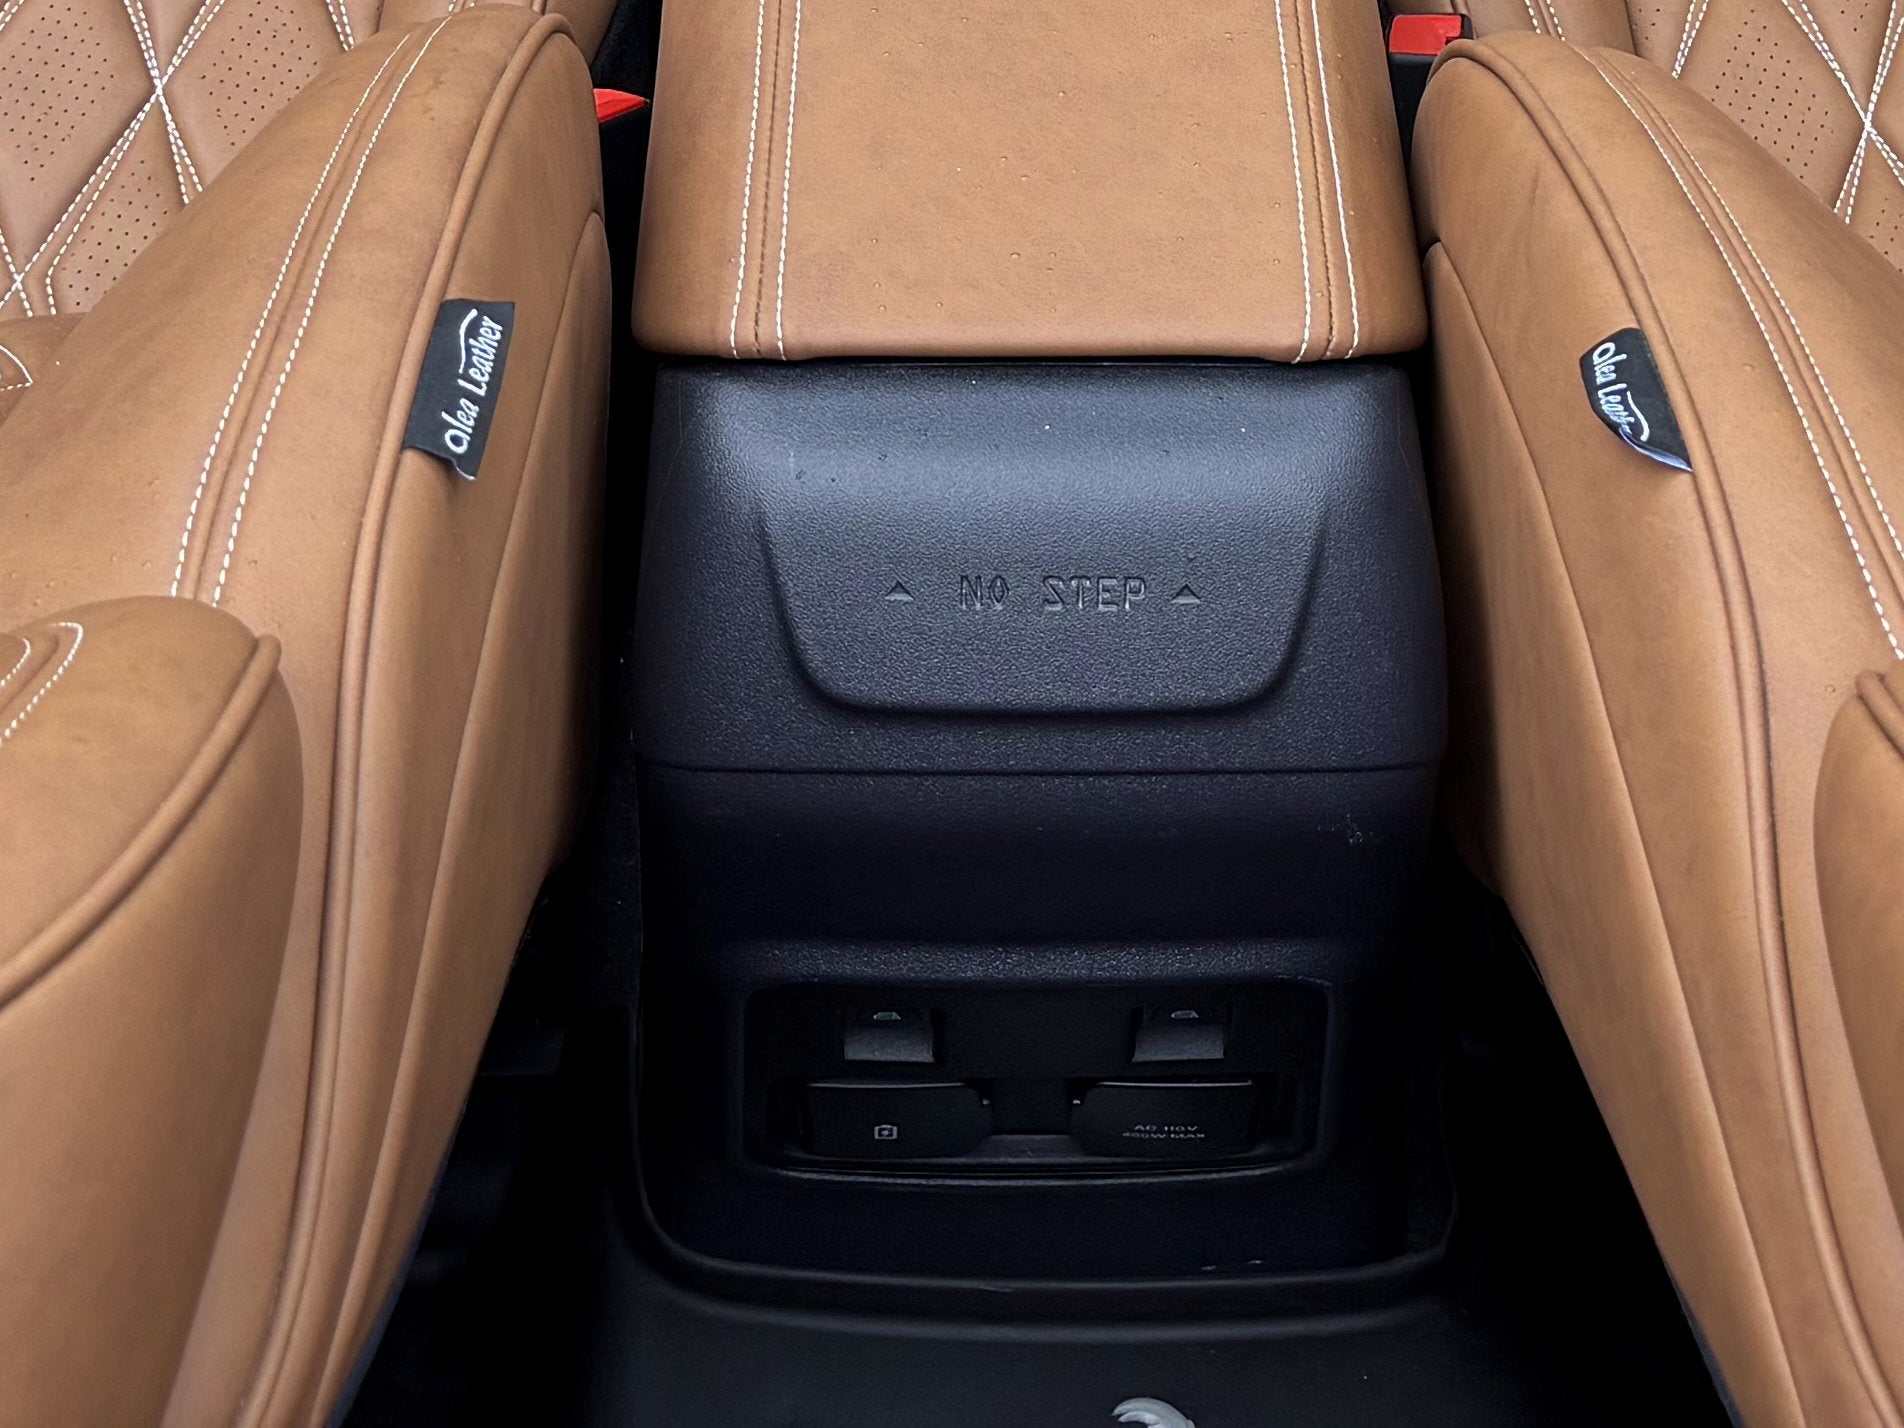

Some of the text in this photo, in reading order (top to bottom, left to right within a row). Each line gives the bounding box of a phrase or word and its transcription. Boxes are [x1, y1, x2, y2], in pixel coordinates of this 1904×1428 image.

[457, 315, 504, 397] Leather
[960, 574, 1146, 611] NO STEP
